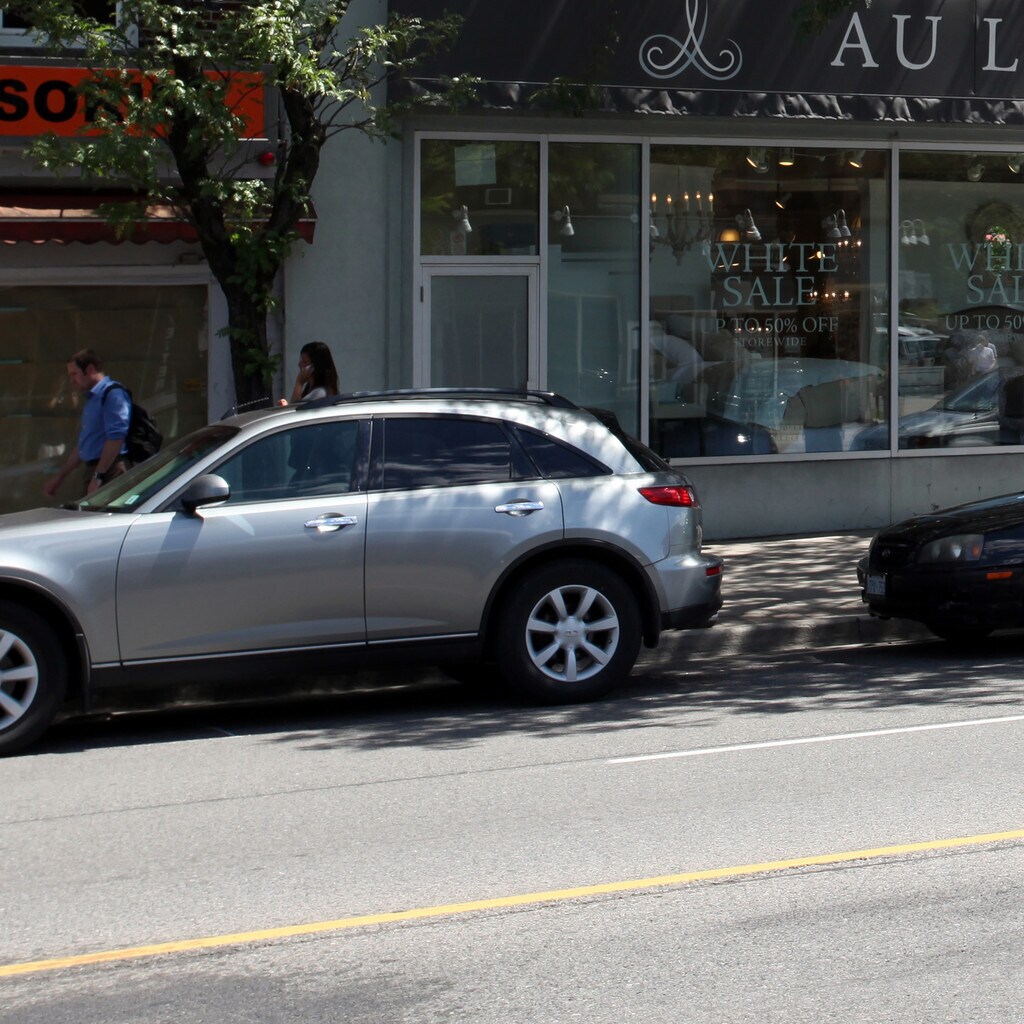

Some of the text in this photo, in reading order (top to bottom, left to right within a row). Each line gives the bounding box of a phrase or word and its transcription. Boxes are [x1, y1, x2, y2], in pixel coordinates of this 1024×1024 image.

[830, 11, 943, 71] AU
[703, 242, 839, 273] WHITE
[723, 275, 817, 307] SALE
[730, 317, 759, 333] TO
[765, 317, 798, 333] 50%
[802, 316, 839, 333] OFF
[945, 315, 969, 330] UP
[973, 314, 999, 330] TO
